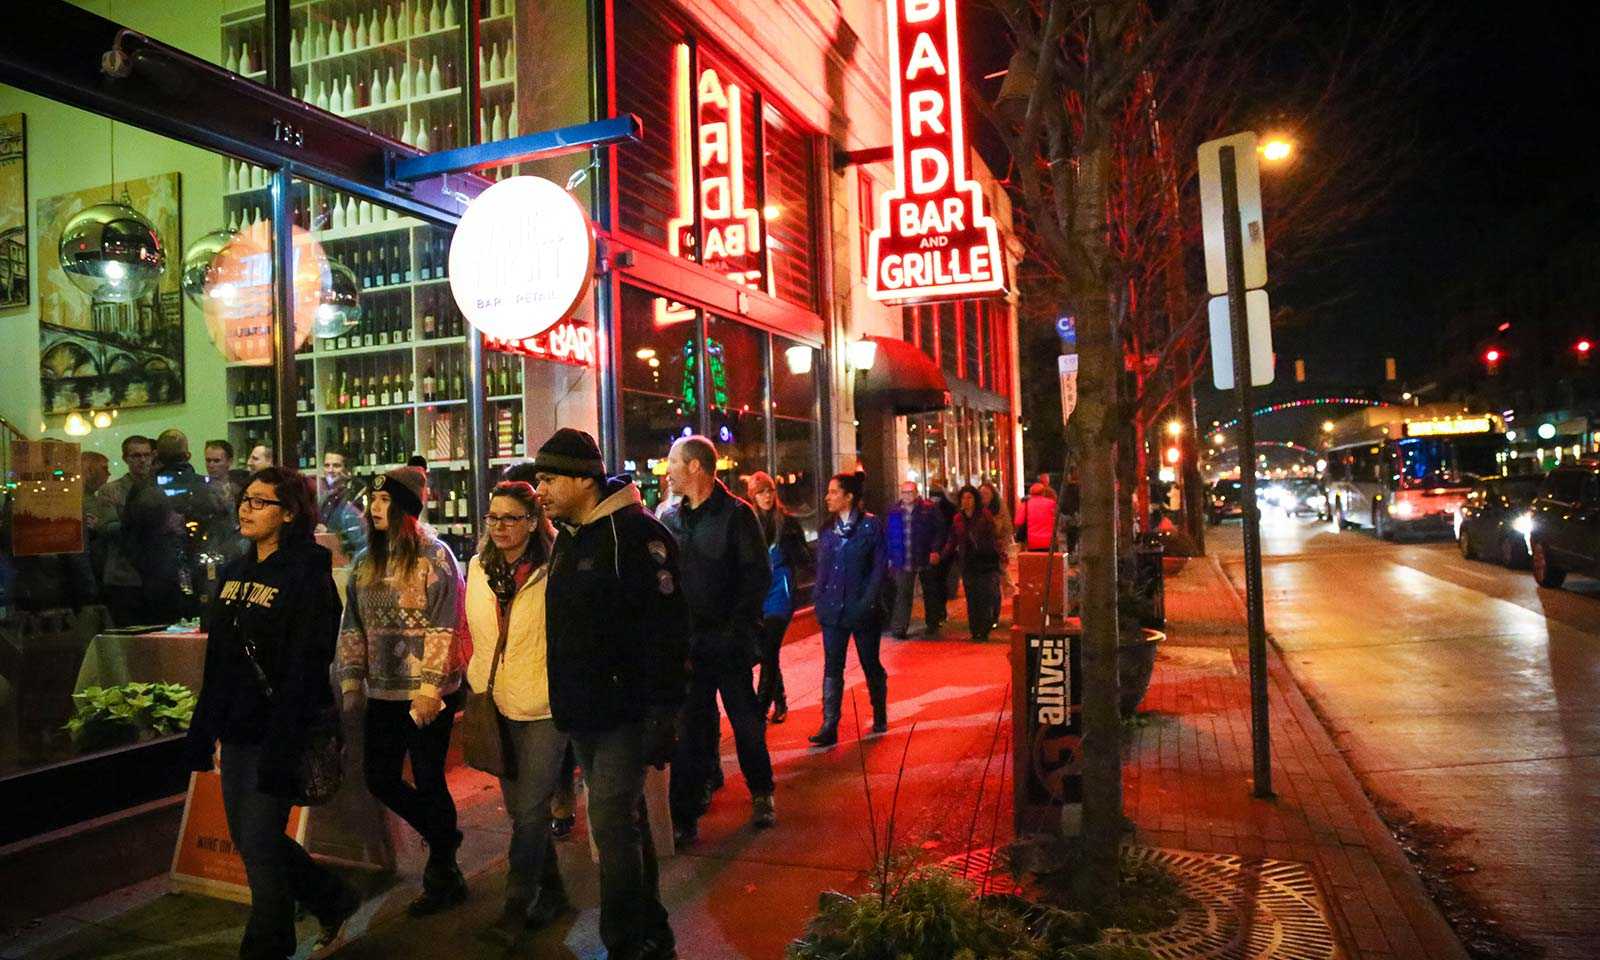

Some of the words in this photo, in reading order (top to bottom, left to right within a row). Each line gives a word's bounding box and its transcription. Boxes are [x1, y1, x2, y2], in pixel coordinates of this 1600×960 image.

[899, 198, 965, 237] BAR
[919, 235, 949, 249] AND
[880, 246, 991, 290] GRILLE
[550, 324, 593, 362] BAR
